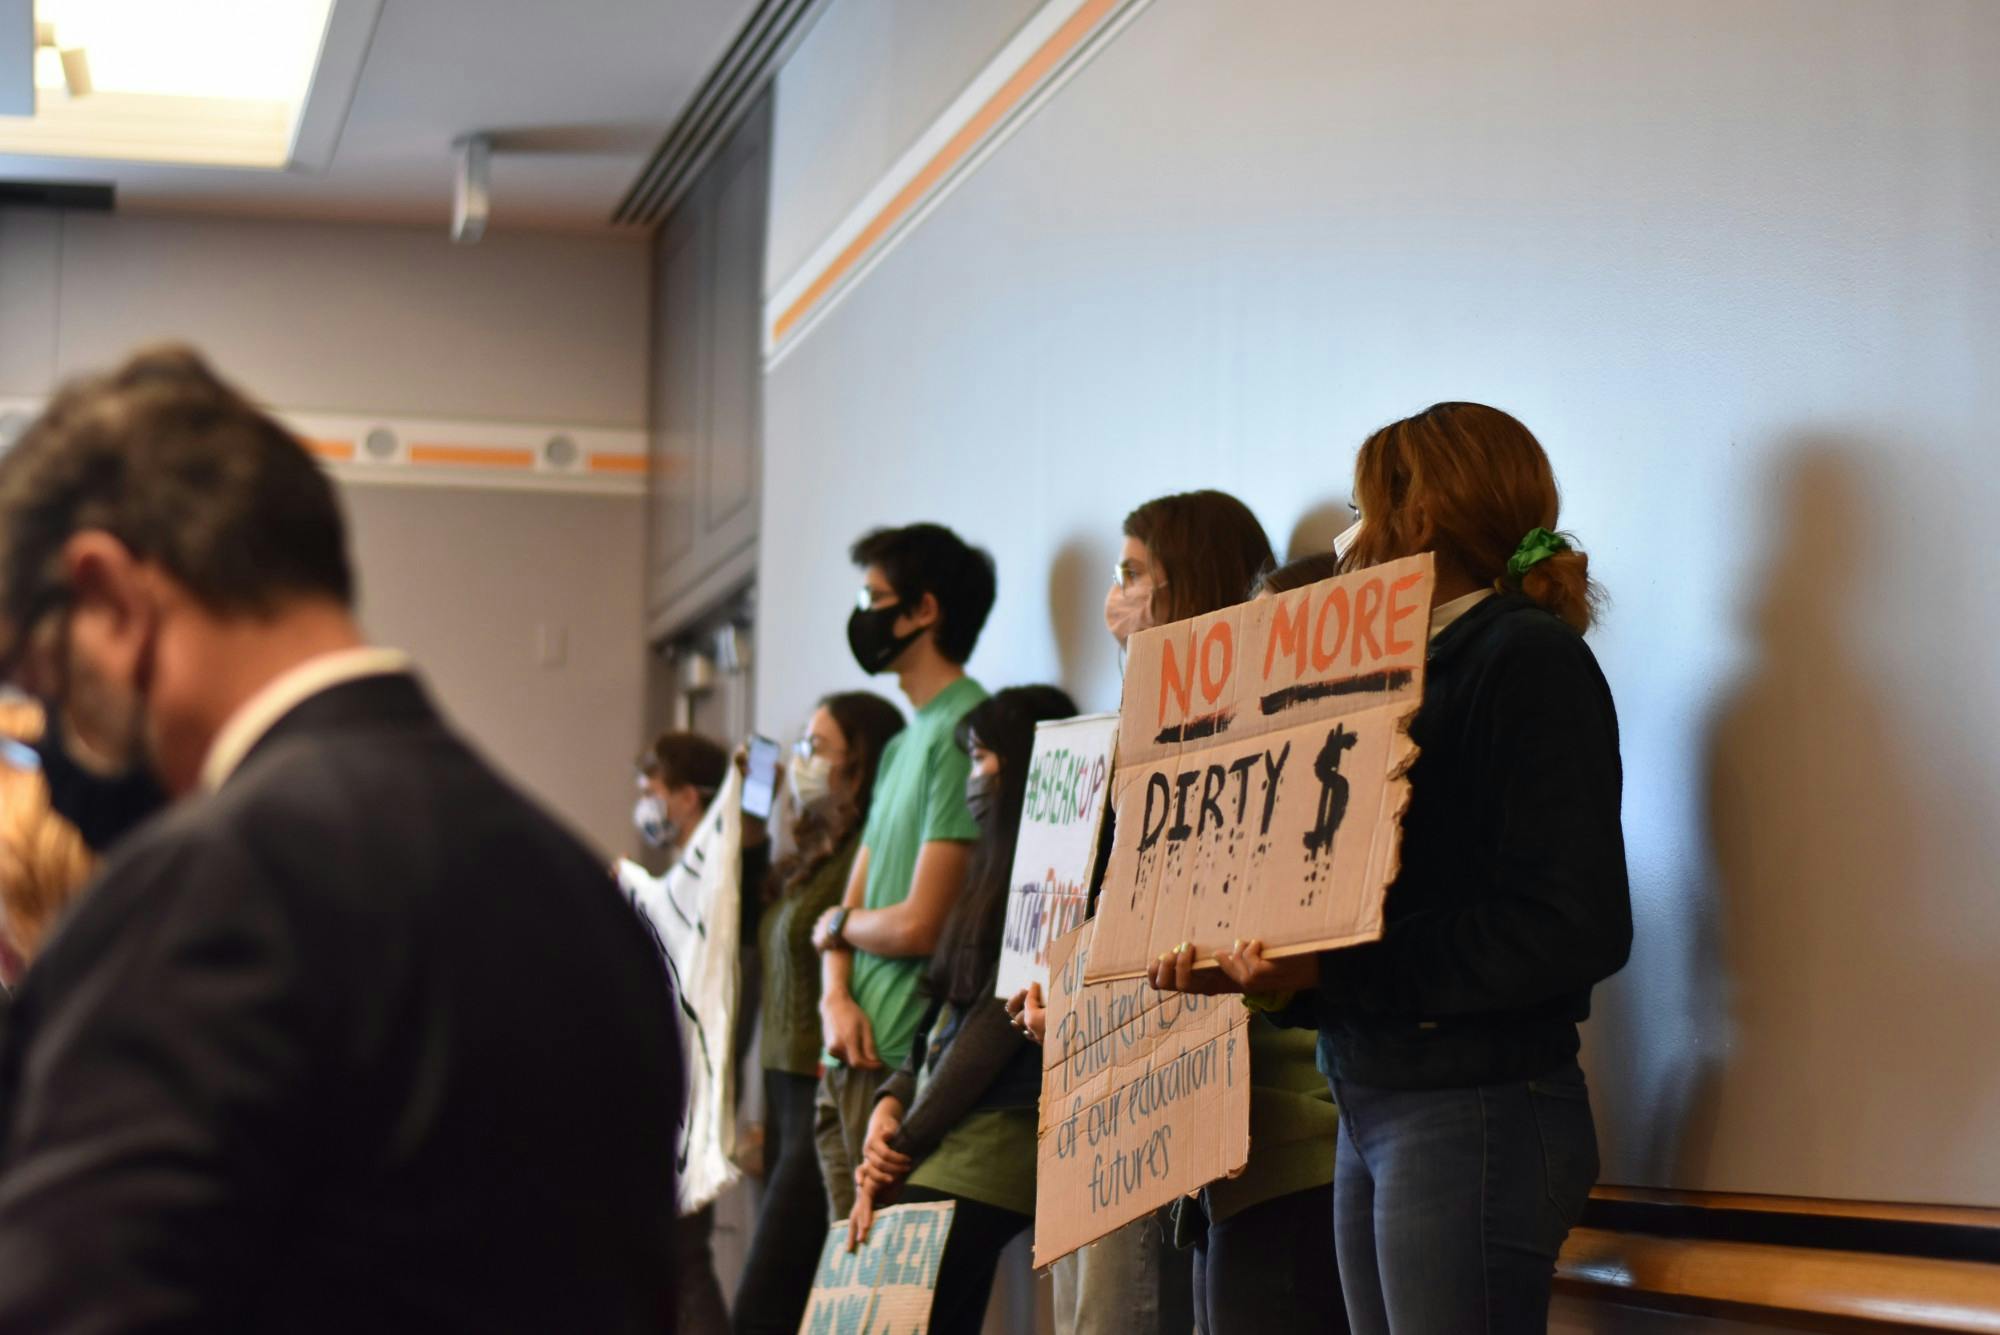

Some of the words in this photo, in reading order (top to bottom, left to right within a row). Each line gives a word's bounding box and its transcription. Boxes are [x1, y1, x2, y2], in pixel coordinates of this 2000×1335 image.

[1158, 620, 1233, 728] NO
[1262, 571, 1425, 682] MORE
[1027, 748, 1105, 825] #BREAKUP
[1136, 740, 1291, 853] DIRTY
[1303, 721, 1358, 853] $
[1056, 980, 1148, 1093] Polluters
[1057, 1095, 1081, 1159] of
[1088, 1083, 1125, 1146] our
[1129, 1039, 1217, 1124] education
[1088, 1124, 1172, 1213] futures
